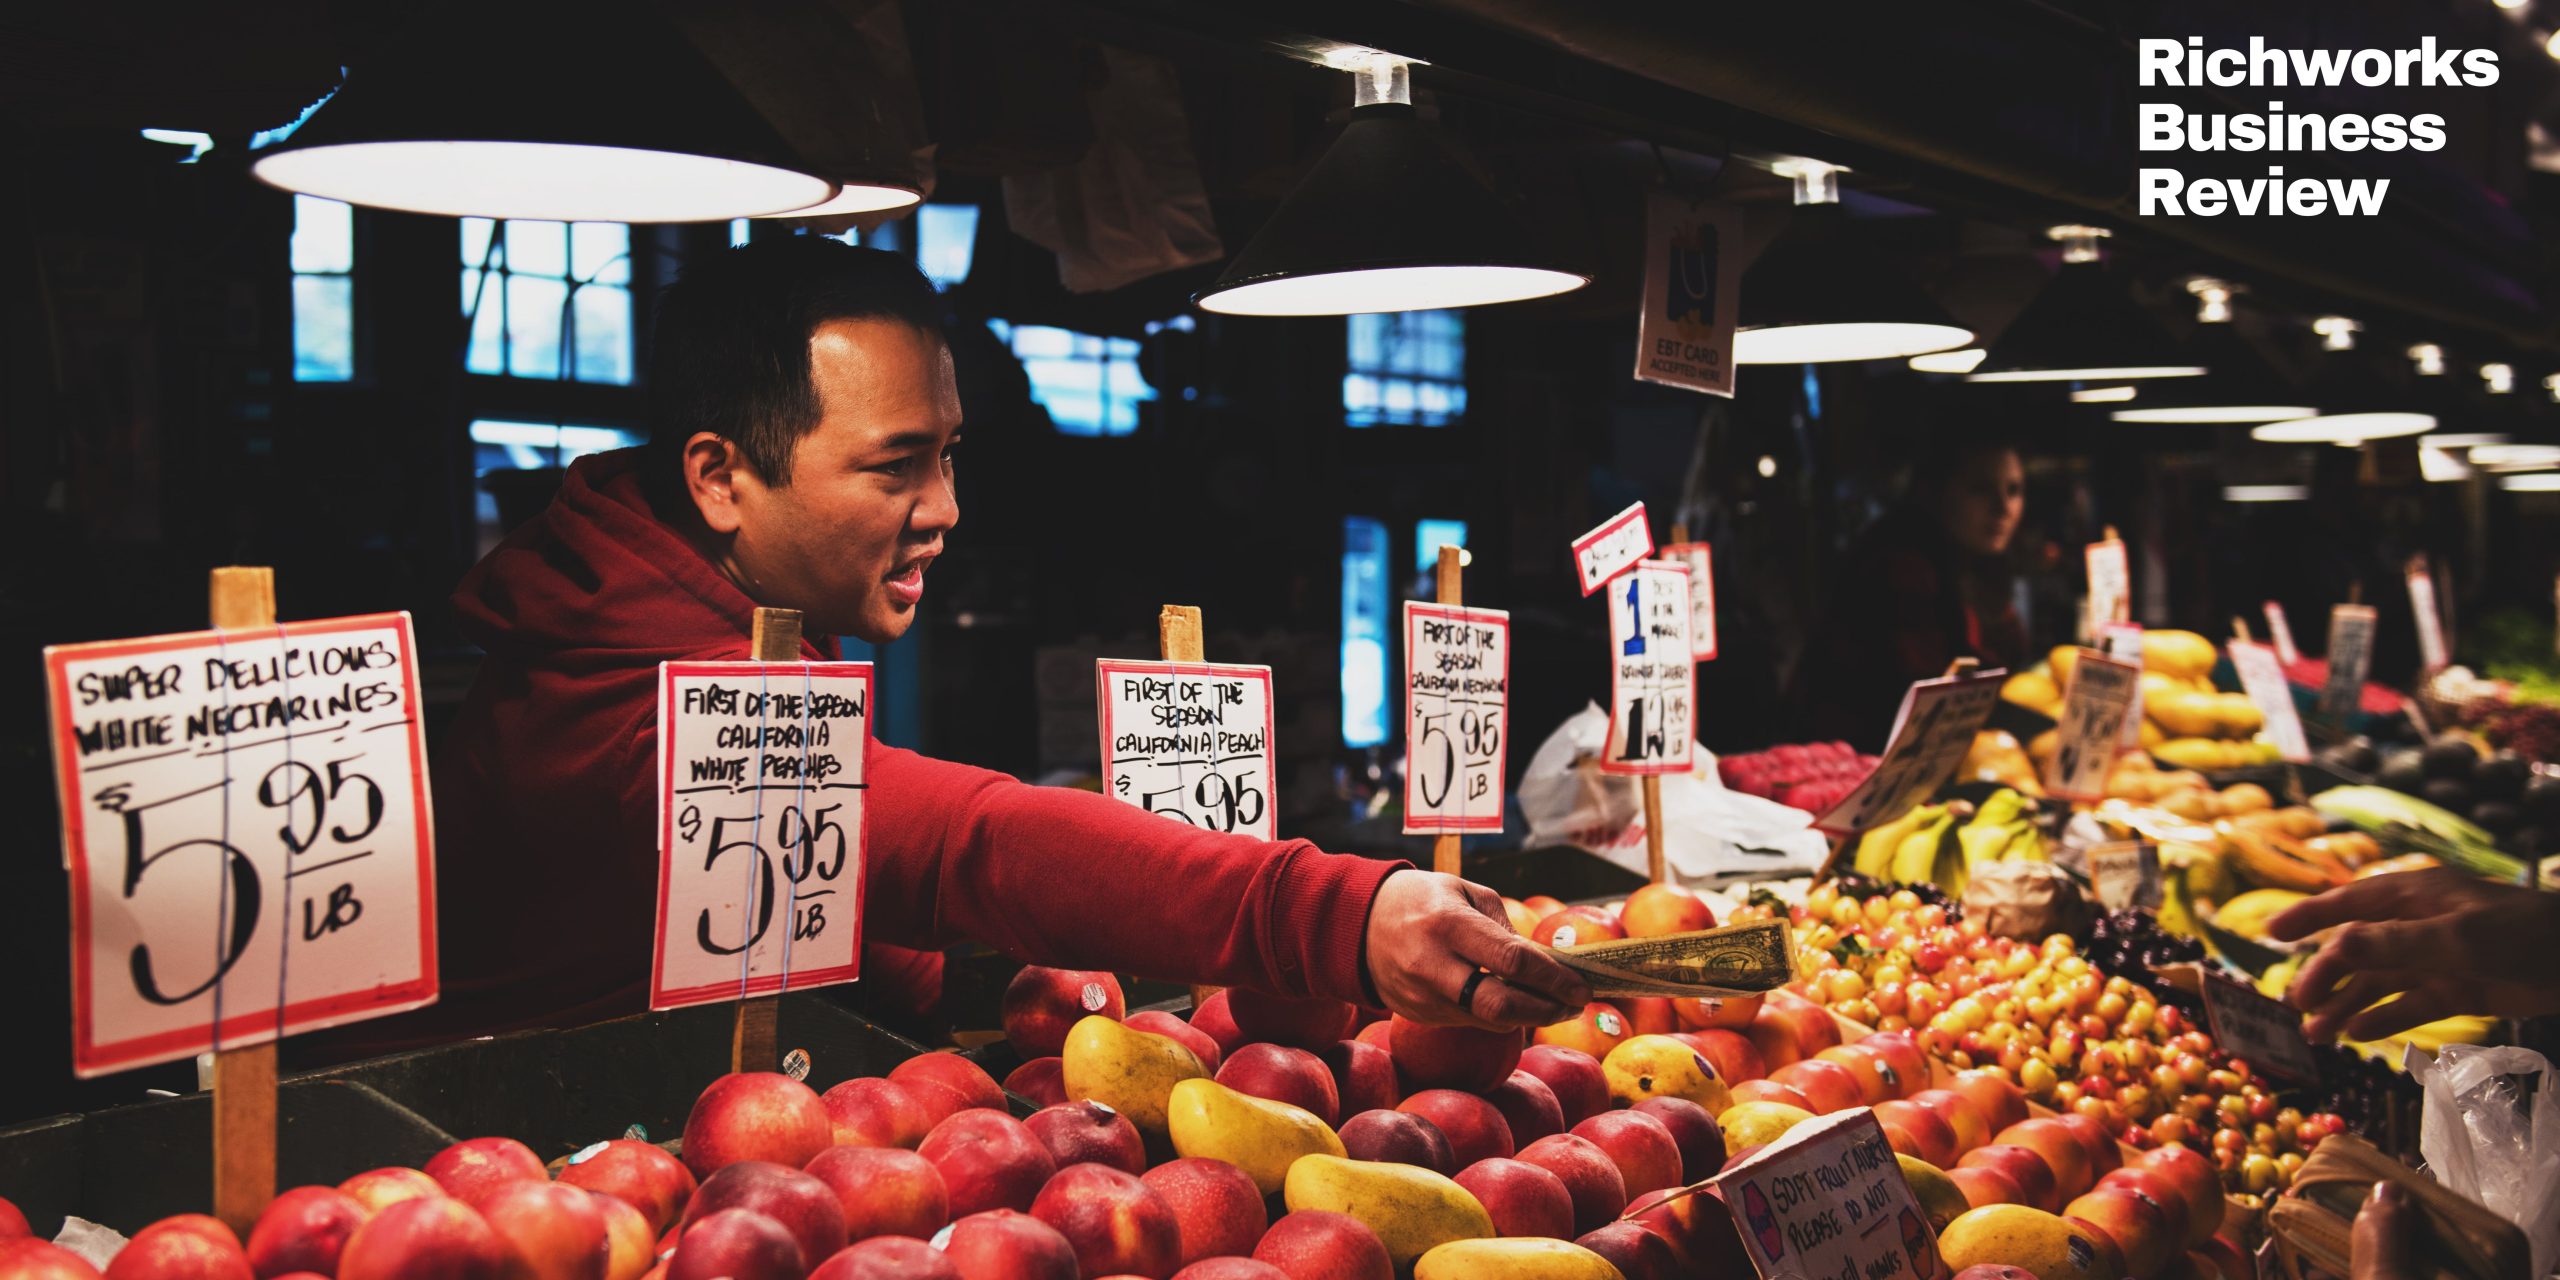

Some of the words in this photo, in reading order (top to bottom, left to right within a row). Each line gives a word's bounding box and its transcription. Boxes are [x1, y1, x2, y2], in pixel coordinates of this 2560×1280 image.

[1657, 337, 1682, 357] EBT
[1684, 343, 1719, 366] CARD
[1650, 358, 1697, 378] ACCEPTED
[1455, 624, 1471, 647] OF
[77, 664, 182, 705] SUPER
[205, 641, 397, 692] DELICIOUS
[684, 683, 741, 716] FIRST
[744, 692, 771, 718] OF
[771, 693, 804, 720] THE
[1124, 677, 1174, 705] FIRST
[1179, 682, 1203, 703] OF
[1212, 681, 1244, 706] THE
[74, 716, 175, 756] WHITE
[186, 682, 399, 740] NECTARINES
[1151, 704, 1224, 729] SEASON
[716, 720, 830, 750] CALIFORNIA
[1115, 732, 1212, 755] CALIFORNIA
[1217, 726, 1266, 755] PEACH
[690, 755, 750, 783] WHITE
[760, 752, 842, 784] PEACHES
[1468, 773, 1489, 801] LB
[303, 882, 363, 941] LB
[794, 902, 827, 943] LB
[1772, 1170, 1816, 1215] SOFT
[1814, 1149, 1857, 1192] FRUIT
[1787, 1207, 1844, 1256] PLEASE
[1843, 1199, 1864, 1226] DO
[1862, 1178, 1892, 1217] NOT
